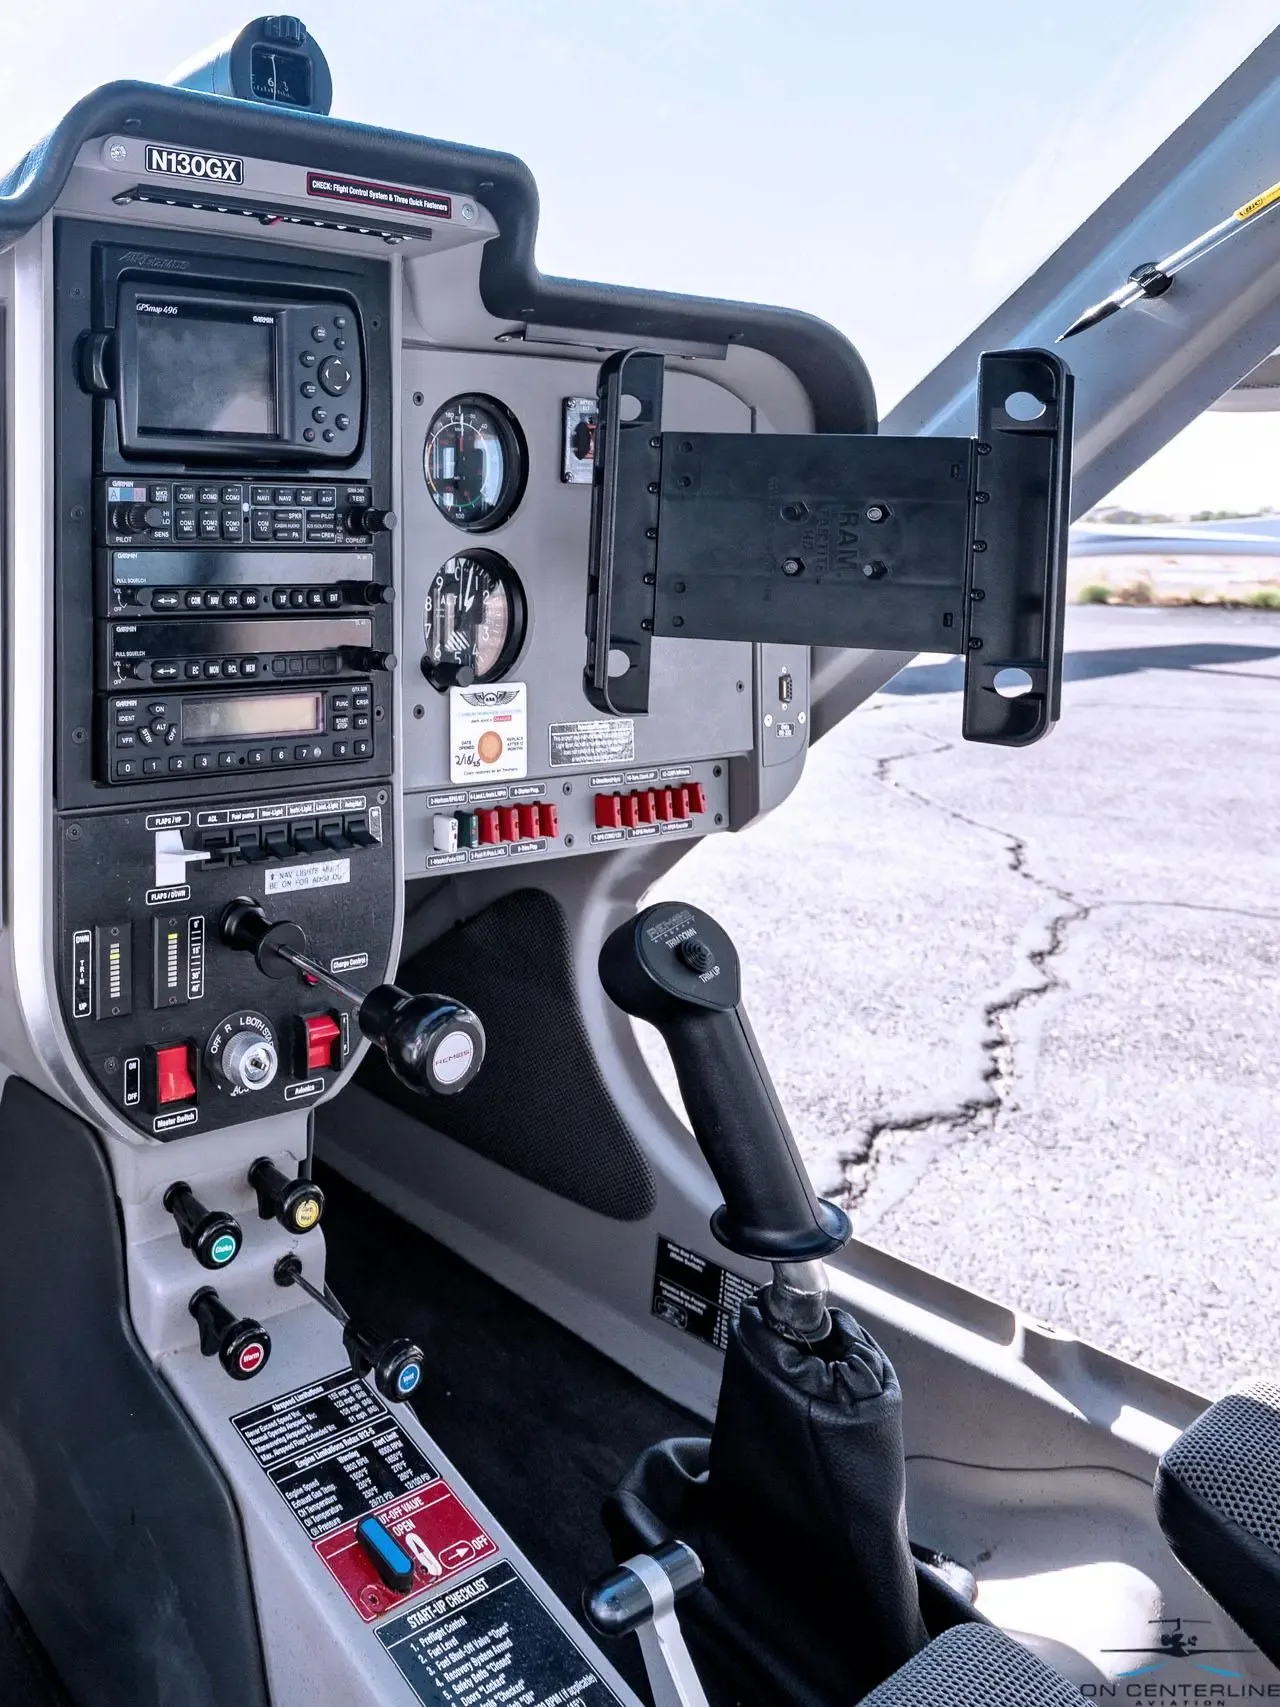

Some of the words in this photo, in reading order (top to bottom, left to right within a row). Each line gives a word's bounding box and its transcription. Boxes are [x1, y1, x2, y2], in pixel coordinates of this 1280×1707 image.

[151, 149, 237, 181] N130GX
[311, 179, 333, 191] CHECK:
[332, 182, 349, 194] Flight
[349, 185, 369, 197] Control
[368, 188, 389, 201] System
[388, 192, 393, 201] &
[393, 193, 408, 204] Three
[408, 195, 423, 207] Quick
[423, 198, 448, 211] Fasteners
[136, 303, 163, 314] GPSmap
[163, 305, 178, 315] 496
[252, 315, 274, 324] GARMIN
[436, 576, 444, 592] 9
[424, 596, 432, 612] 8
[482, 590, 490, 605] 2
[424, 623, 432, 639] 7
[482, 625, 490, 641] 3
[434, 644, 442, 659] 6
[455, 652, 462, 665] 5
[472, 644, 479, 657] 4
[142, 728, 153, 744] STBY
[224, 1023, 233, 1034] R
[239, 1018, 245, 1026] L
[246, 1016, 266, 1031] BOTH
[210, 1034, 223, 1054] OFF
[176, 1112, 195, 1125] Switch
[243, 1352, 260, 1363] Warm
[272, 1394, 297, 1412] Airspeed
[295, 1385, 325, 1403] Limitations
[294, 1454, 316, 1469] Engine
[314, 1440, 346, 1461] Limitations
[401, 1496, 425, 1513] VALVE
[391, 1518, 417, 1538] OPEN
[471, 1535, 489, 1551] OFF
[406, 1600, 447, 1630] START-UP
[445, 1577, 490, 1610] CHECKLIST
[410, 1643, 420, 1653] 1.
[419, 1627, 447, 1650] Preflight
[444, 1615, 468, 1635] Control
[418, 1654, 427, 1665] 2.
[427, 1644, 441, 1660] Fuel
[440, 1636, 460, 1653] Level
[426, 1665, 436, 1676] 3.
[435, 1656, 450, 1672] Fuel
[448, 1641, 474, 1664] Shut-Off
[472, 1635, 491, 1651] Valve
[488, 1622, 511, 1641] "Open"
[435, 1677, 445, 1688] 4.
[444, 1659, 472, 1683] Recovery
[470, 1647, 494, 1670] System
[492, 1637, 514, 1656] Armed
[452, 1678, 474, 1696] Safety
[472, 1669, 490, 1687] Belts
[485, 1654, 513, 1677] "Closed"
